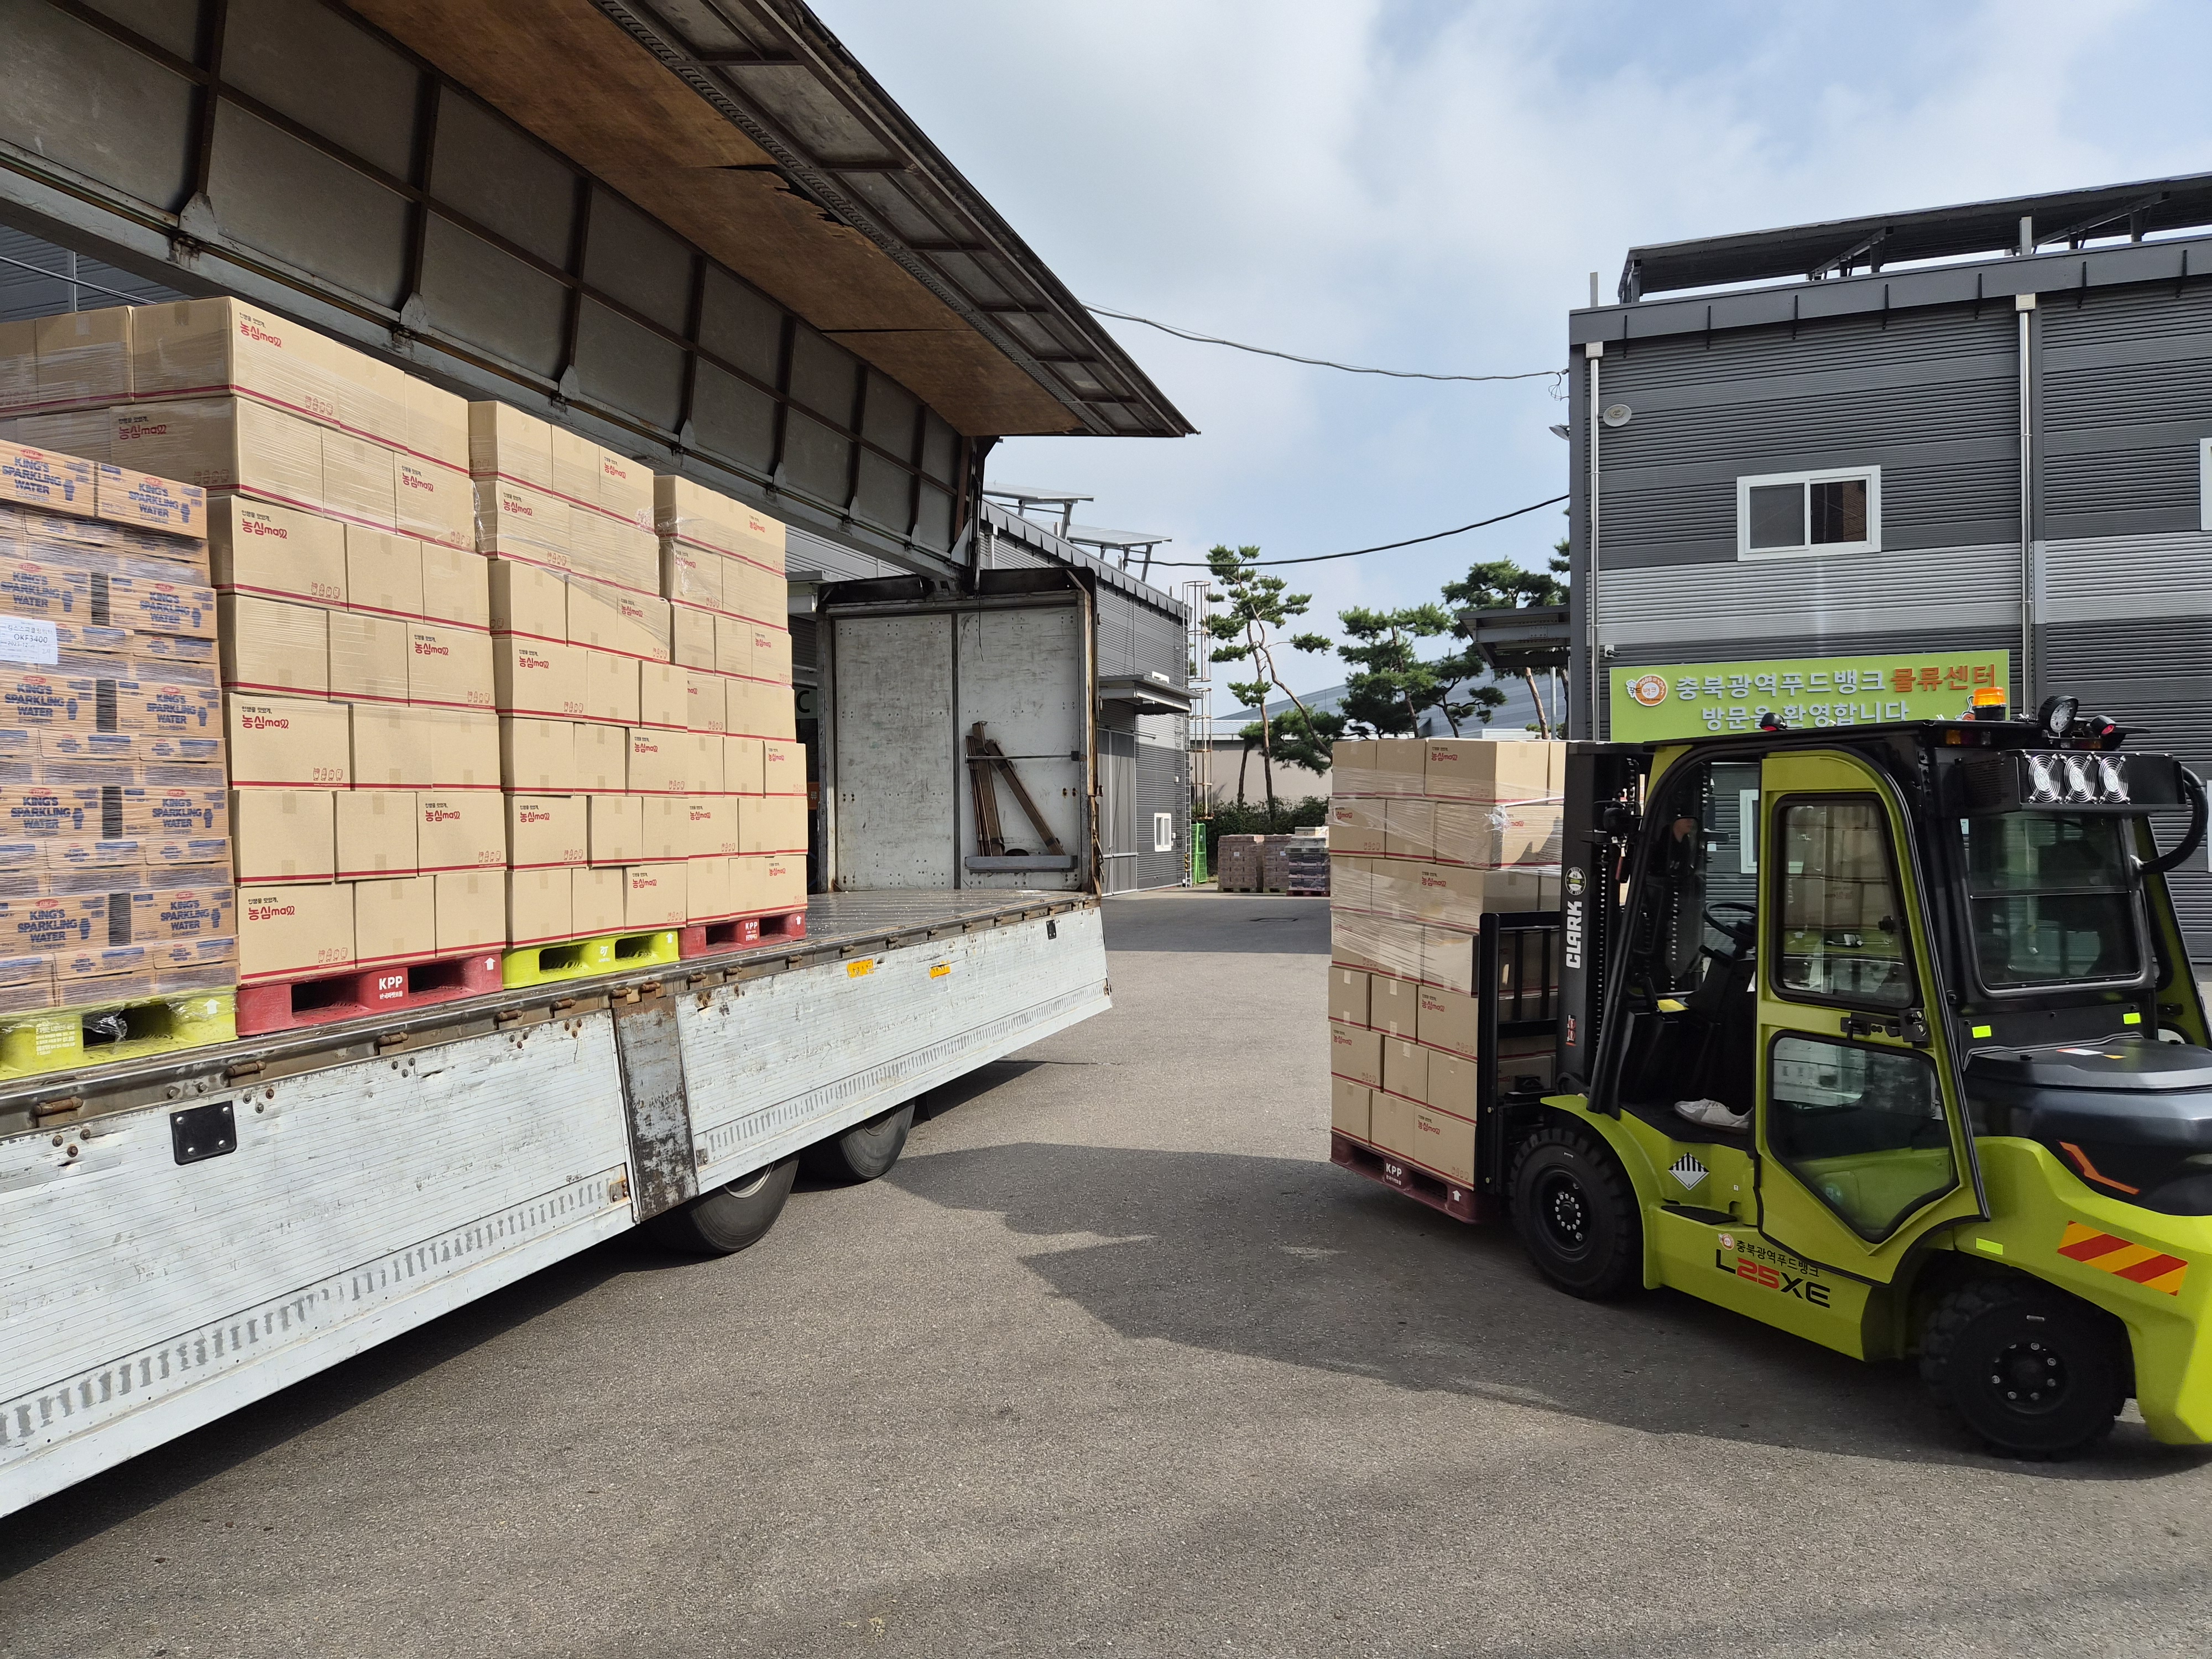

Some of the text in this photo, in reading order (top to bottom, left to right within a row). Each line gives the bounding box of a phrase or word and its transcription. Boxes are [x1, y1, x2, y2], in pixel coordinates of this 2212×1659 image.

[14, 633, 48, 643] OKF3400
[1676, 664, 1995, 700] 충북광역푸드뱅크 물류센터
[1783, 701, 1910, 728] 환영합니다
[30, 909, 65, 920] KING'S
[18, 919, 77, 932] SPARKLING
[745, 921, 758, 930] KPP
[30, 932, 66, 943] WATER
[1566, 901, 1582, 969] CLARK
[379, 975, 403, 990] KPP
[1386, 1162, 1402, 1177] KPP
[1736, 1240, 1819, 1277] 충북광역푸드뱅크
[1716, 1249, 1830, 1308] L25XE
